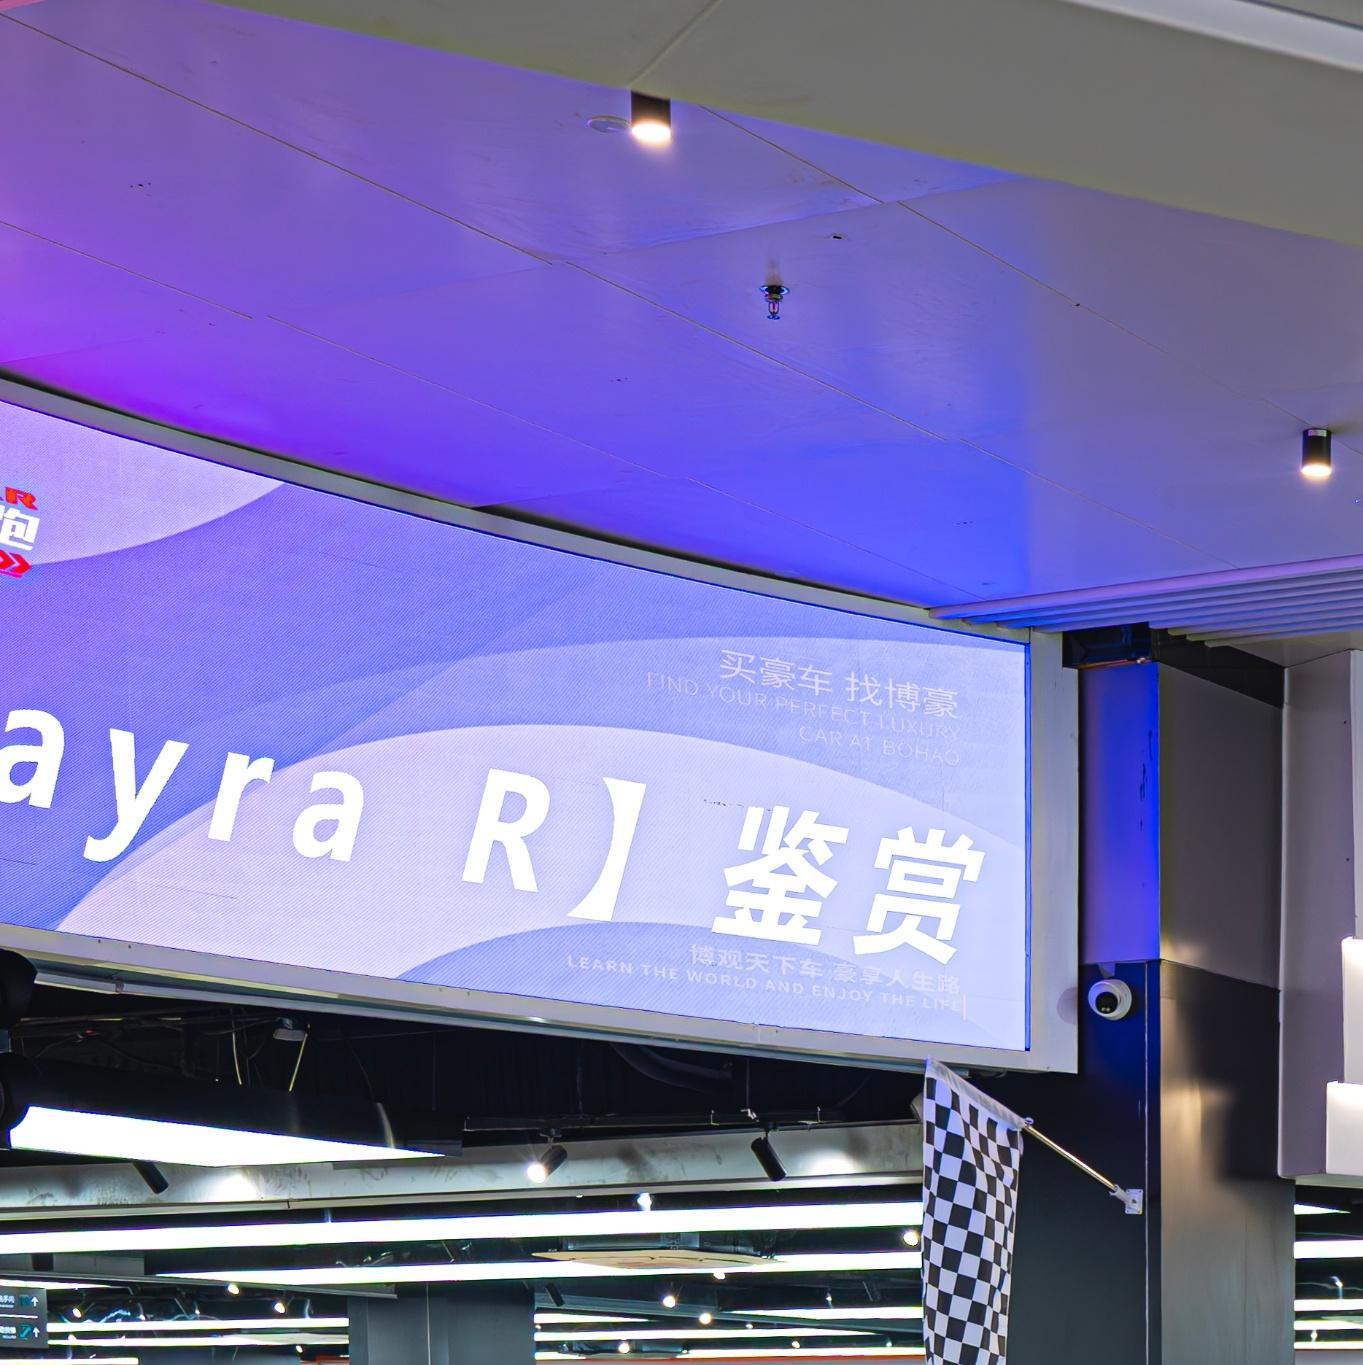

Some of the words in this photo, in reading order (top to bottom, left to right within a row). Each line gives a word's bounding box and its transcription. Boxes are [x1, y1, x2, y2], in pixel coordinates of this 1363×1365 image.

[646, 670, 698, 697] FIND
[706, 684, 768, 711] YOUR
[775, 695, 872, 727] PERFECT
[879, 714, 962, 741] LUXURY
[719, 649, 833, 696] 买豪车
[844, 670, 959, 720] 找博豪
[799, 725, 842, 746] CAR
[849, 735, 873, 752] AT
[882, 739, 961, 766] BOHAO
[712, 803, 985, 965] 鉴赏
[566, 954, 633, 975] LEARN
[641, 963, 679, 980] THE
[686, 968, 758, 990] WORLD
[764, 977, 804, 995] AND
[811, 983, 874, 1003] ENJOY
[880, 991, 915, 1008] THE
[921, 996, 962, 1013] LIFE
[689, 943, 824, 979] 博观天下车
[833, 963, 961, 995] 豪享人生路
